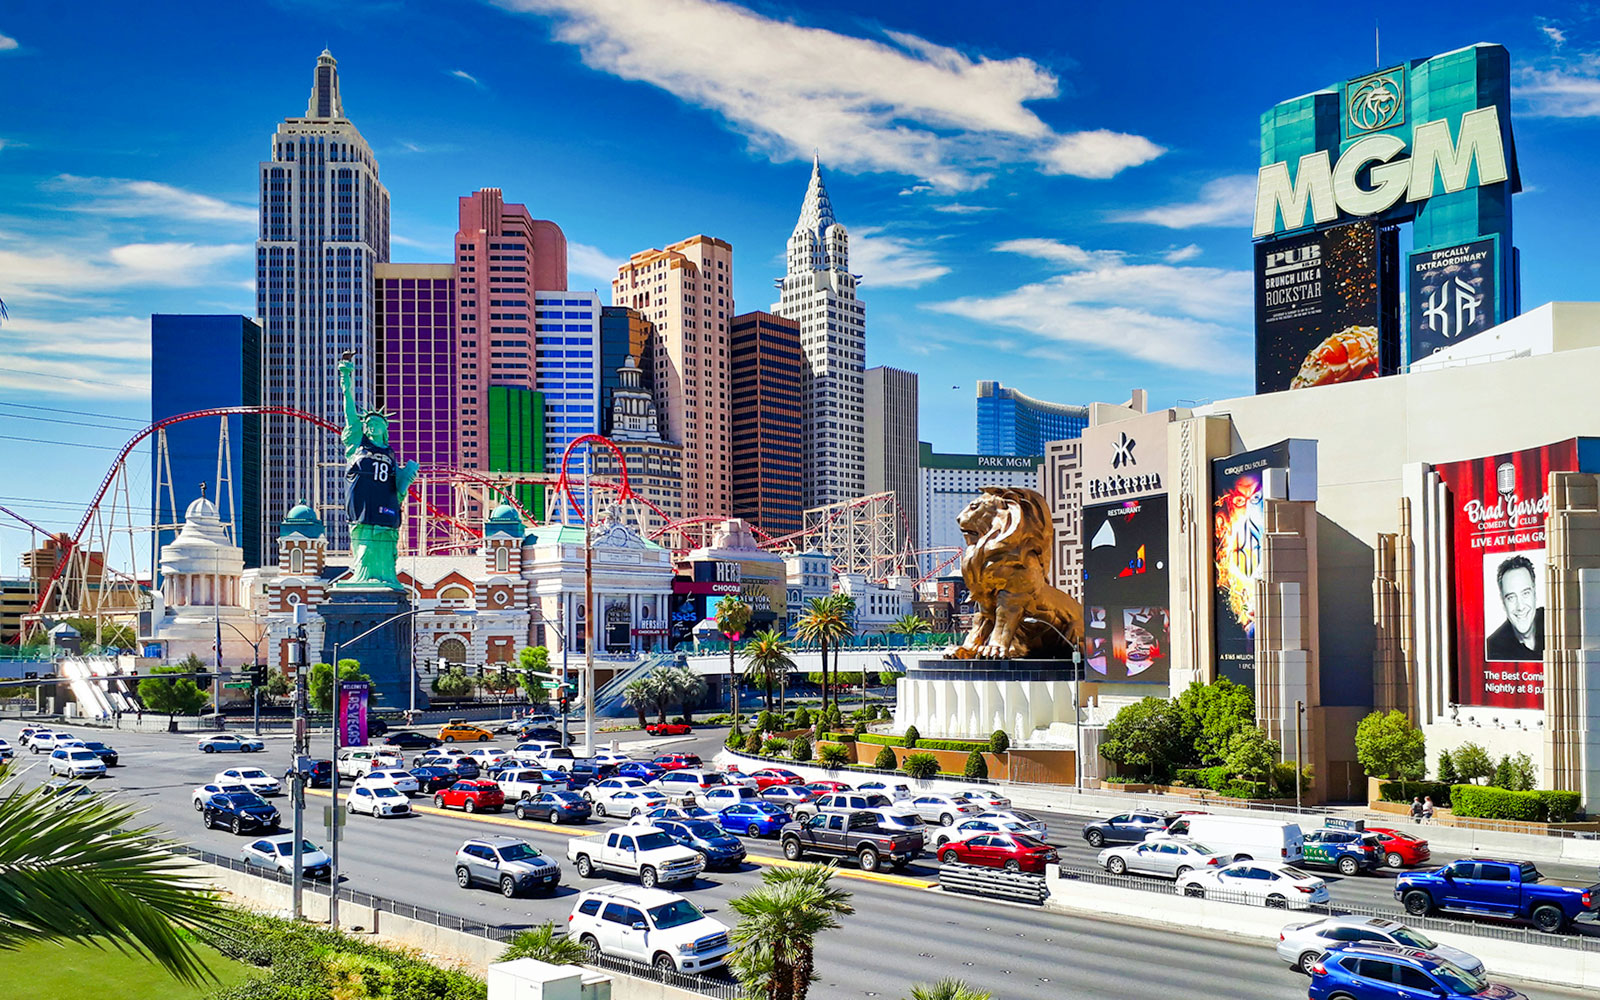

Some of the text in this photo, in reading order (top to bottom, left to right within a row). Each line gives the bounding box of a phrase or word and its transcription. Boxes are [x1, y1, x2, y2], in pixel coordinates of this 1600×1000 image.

[1252, 104, 1508, 237] MGM
[1266, 244, 1321, 268] PUB
[1416, 251, 1487, 272] EXTRAORDINARY
[1432, 246, 1470, 260] EPICALLY
[1265, 268, 1321, 289] BRUNCH LIKE A
[1265, 282, 1322, 307] ROCKSTAR
[372, 461, 389, 482] 18
[978, 456, 1031, 468] PARK MGM
[1224, 465, 1244, 475] CIRQUE
[1244, 463, 1252, 471] DU
[1087, 472, 1159, 495] Hakkasan
[1107, 505, 1142, 517] RESTAURANT
[1463, 496, 1504, 523] Brad
[1477, 516, 1538, 531] COMEDY CLUB
[1471, 537, 1493, 548] LIVE
[1493, 535, 1506, 546] AT
[1507, 532, 1531, 545] MGM
[1484, 670, 1500, 680] The
[1501, 671, 1520, 681] Best
[1485, 683, 1516, 695] Nightly
[1517, 684, 1526, 693] at
[1527, 684, 1533, 694] 8
[348, 690, 360, 711] LAS
[347, 711, 361, 745] VEGAS
